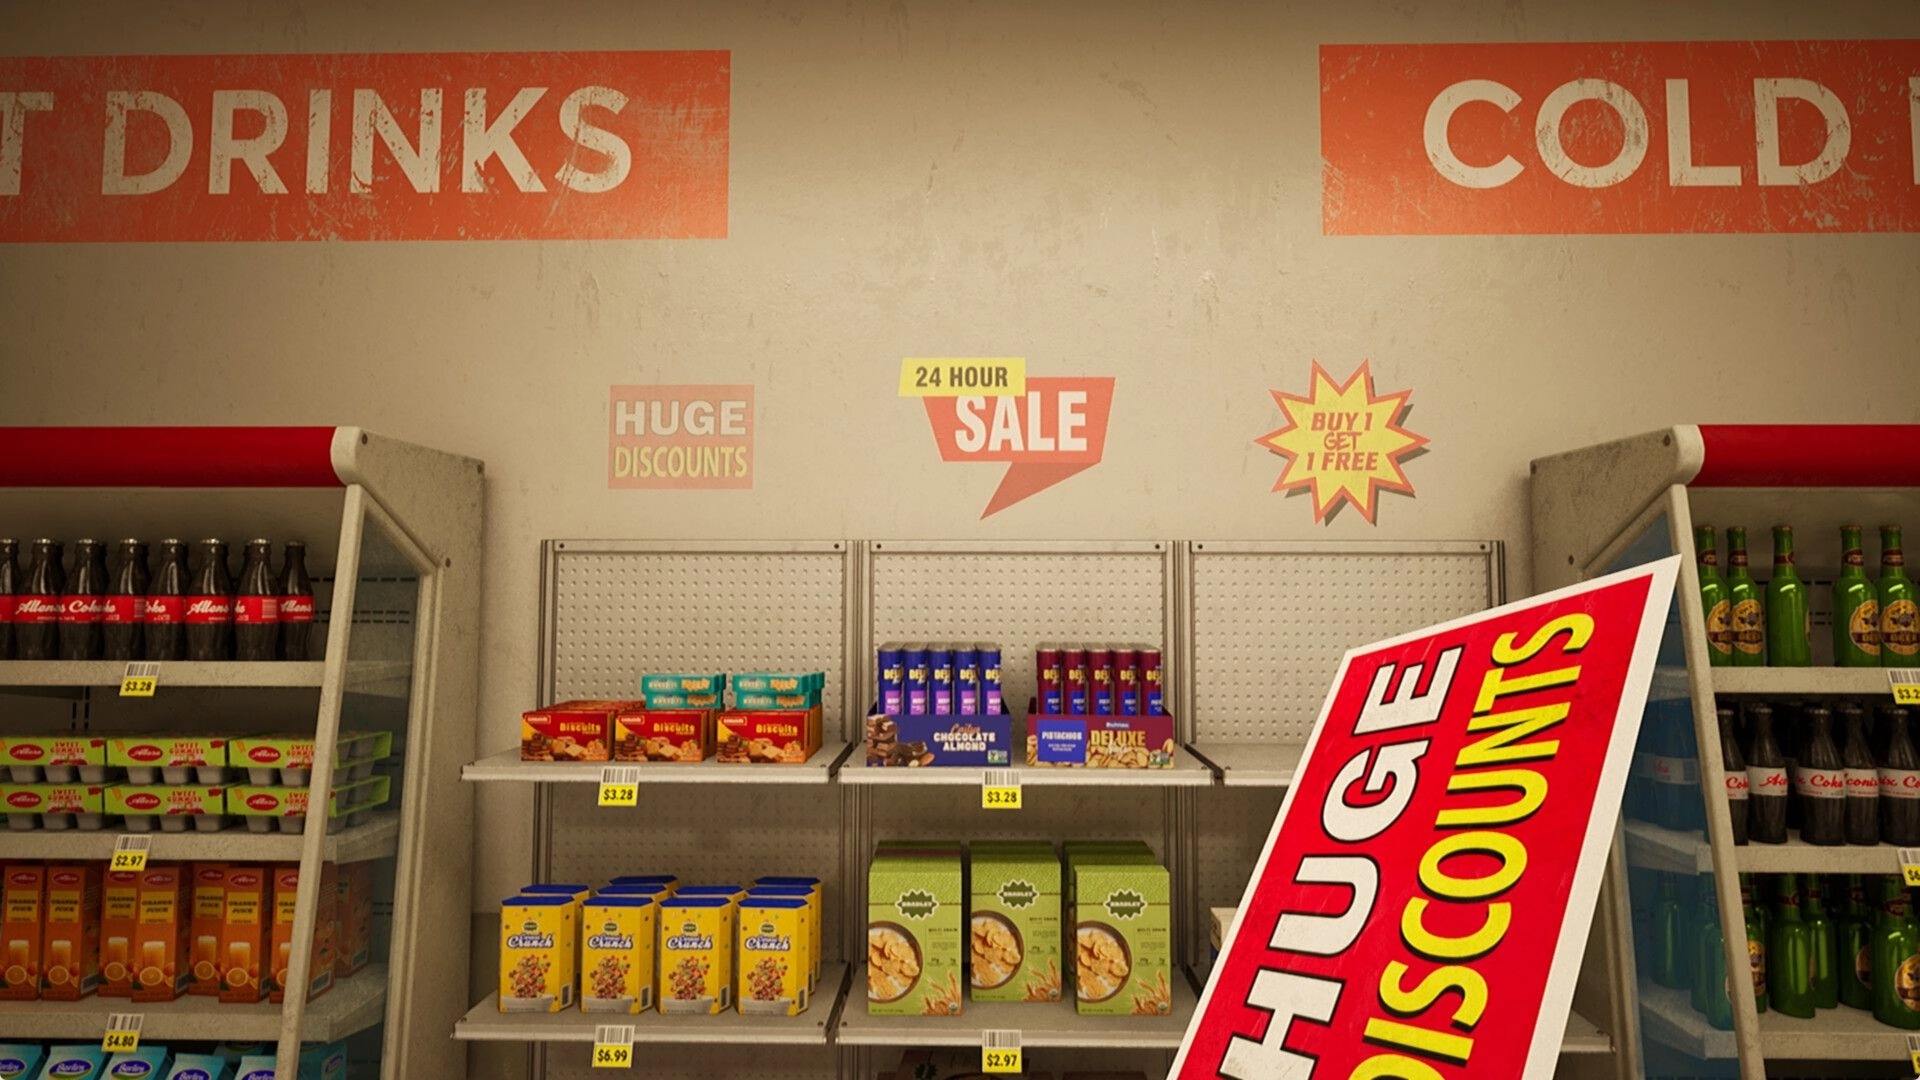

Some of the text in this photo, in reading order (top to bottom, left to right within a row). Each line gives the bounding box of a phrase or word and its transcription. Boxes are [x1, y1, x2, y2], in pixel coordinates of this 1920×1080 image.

[1423, 77, 1851, 188] COLD
[101, 86, 632, 195] DRINKS
[915, 365, 1008, 388] 24 HOUR
[615, 400, 747, 436] HUGE
[954, 390, 1088, 453] SALE
[1311, 412, 1373, 431] BUY 1
[1323, 431, 1362, 450] GET
[614, 445, 748, 479] DISCOUNTS
[1306, 452, 1379, 471] 1 FREE
[124, 679, 152, 693] $3.28
[559, 723, 601, 732] Biscuits
[653, 723, 695, 733] Biscuits
[756, 723, 798, 734] Biscuits
[933, 731, 996, 743] CHOCOLATE
[1090, 730, 1146, 746] DELUXE
[943, 741, 987, 752] ALMOND
[603, 788, 633, 801] $3.28
[987, 791, 1018, 804] $3.28
[115, 855, 143, 867] $2.97
[1216, 643, 1466, 1080] HUGE
[508, 933, 554, 948] Crunch
[588, 934, 633, 949] Crunch
[667, 936, 713, 950] Crunch
[746, 937, 791, 951] Crunch
[107, 1035, 135, 1047] $4.80
[597, 1049, 628, 1063] $6.99
[986, 1054, 1017, 1068] $2.97
